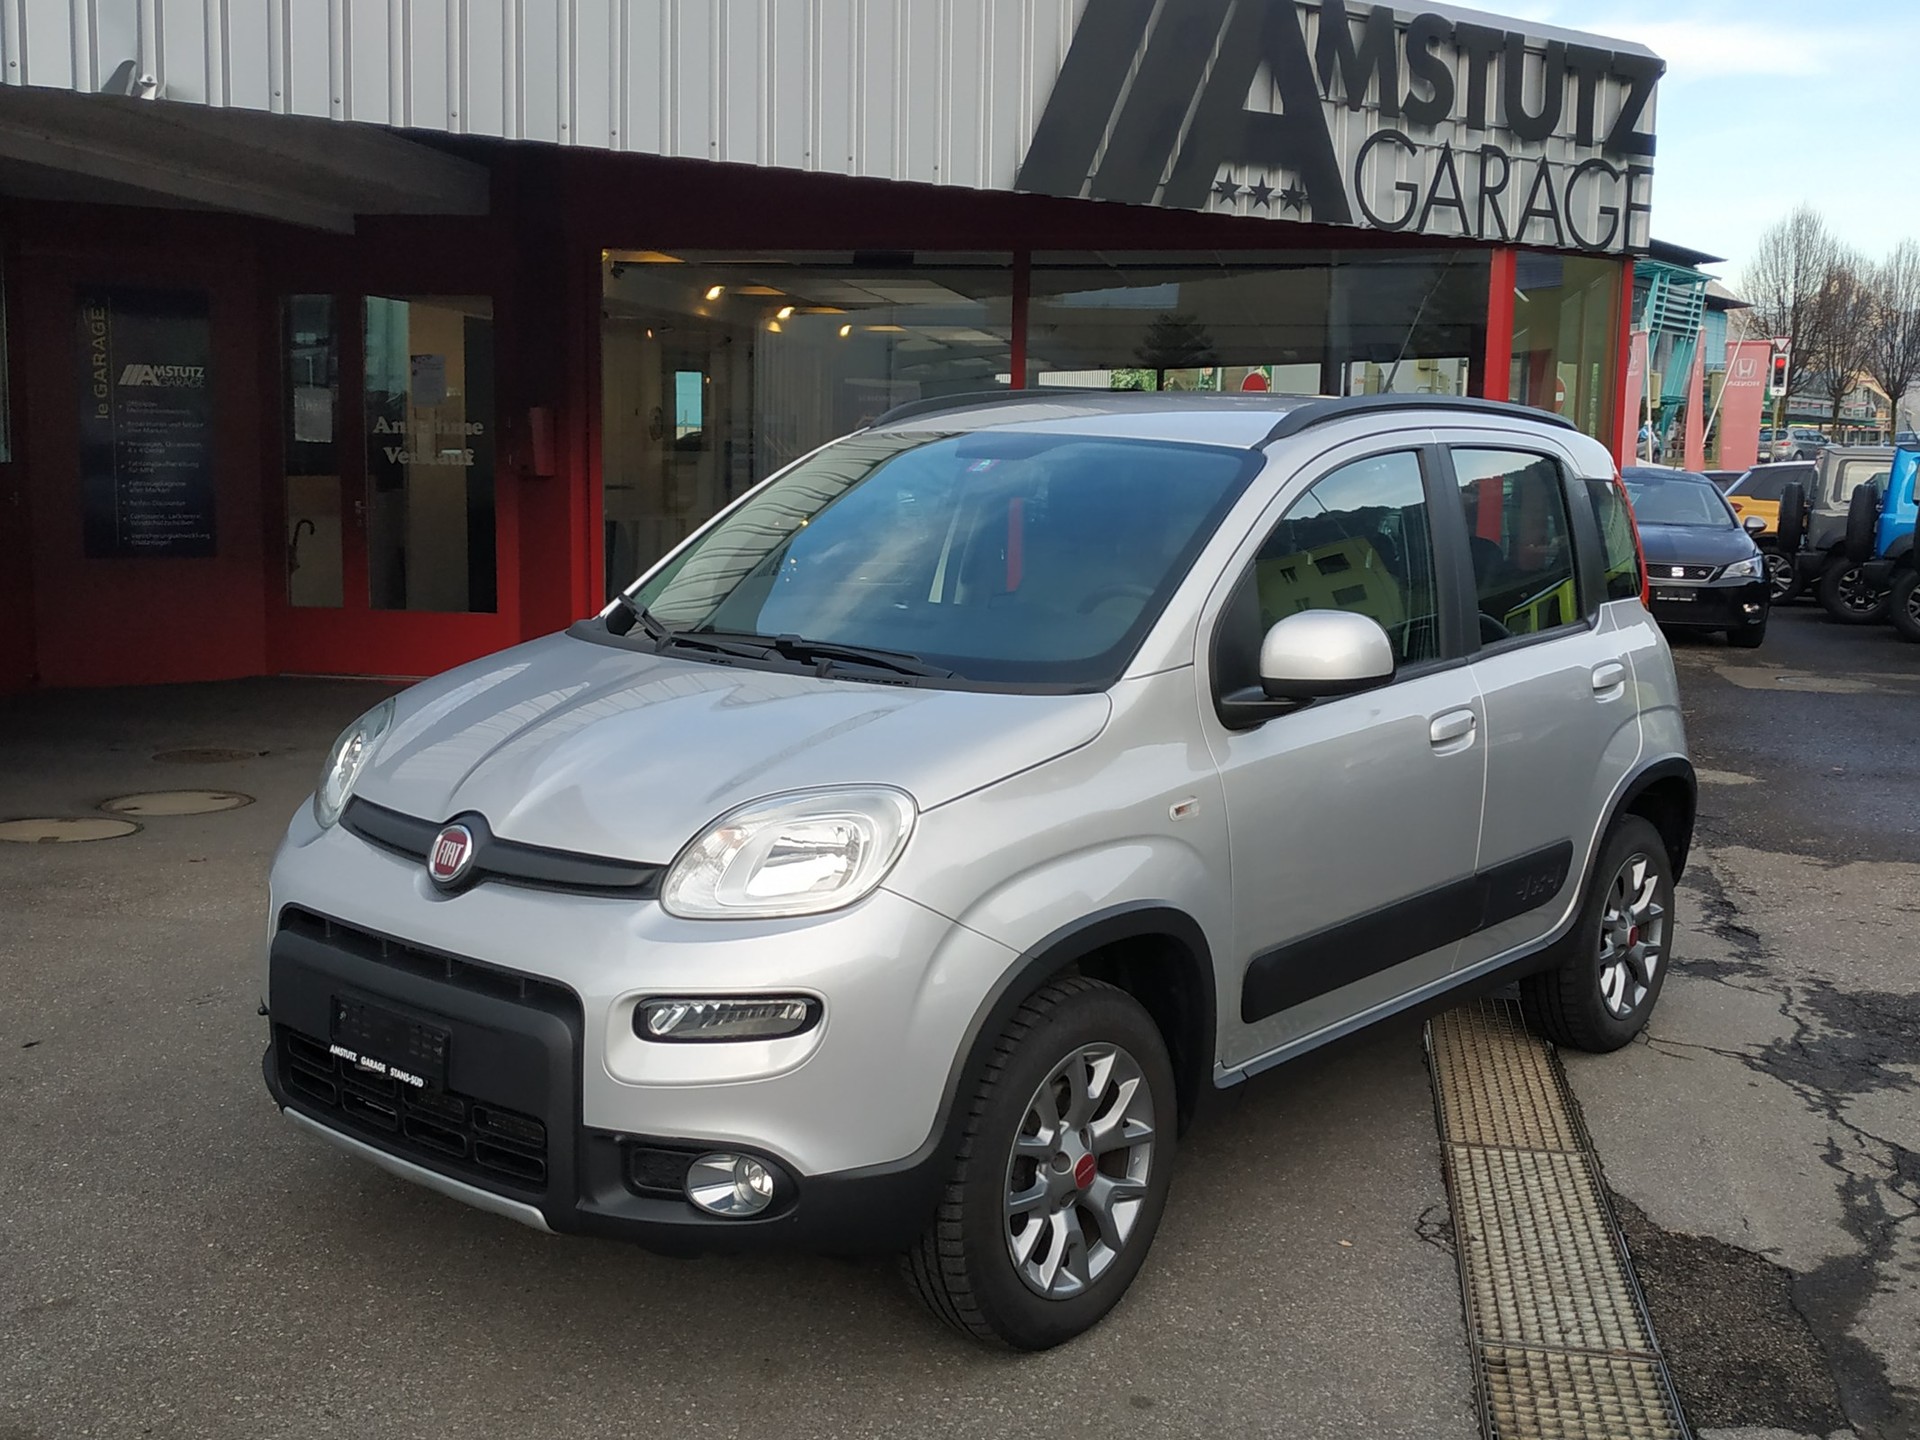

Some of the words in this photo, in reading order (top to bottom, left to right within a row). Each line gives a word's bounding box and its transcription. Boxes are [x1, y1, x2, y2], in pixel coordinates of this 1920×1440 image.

[1163, 0, 1667, 224] AMSTUTZ
[1354, 128, 1655, 256] GARAGE
[91, 307, 109, 398] GARAGE
[133, 364, 205, 386] AMSTUTZ
[159, 376, 205, 388] GARAGE
[372, 415, 484, 435] Anahme
[383, 446, 475, 466] Verauf
[436, 839, 464, 868] FIAT
[329, 1044, 358, 1062] AMSTUTZ
[360, 1055, 387, 1074] GARAGE
